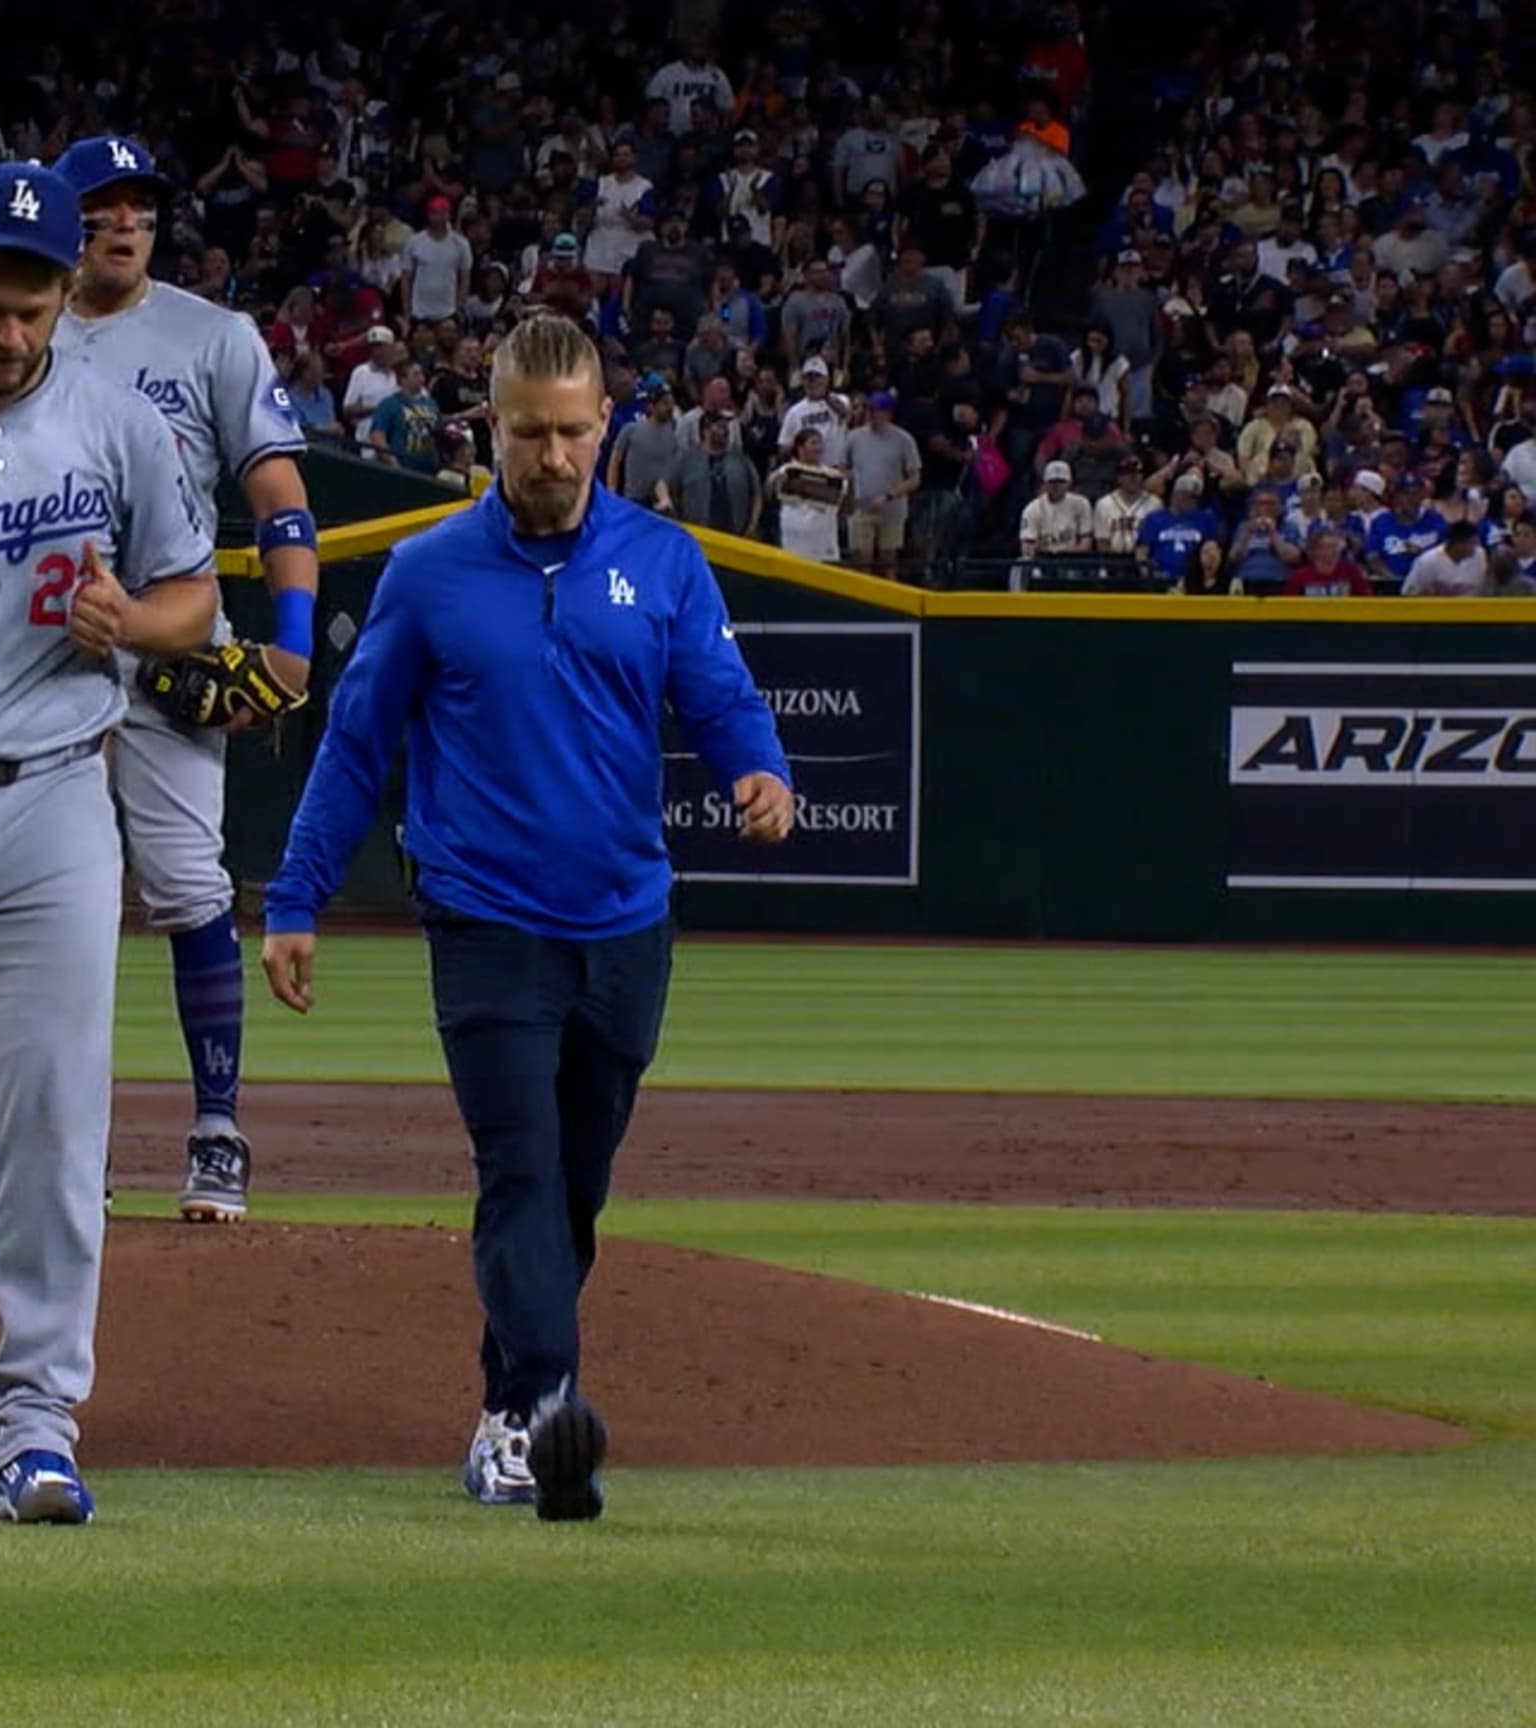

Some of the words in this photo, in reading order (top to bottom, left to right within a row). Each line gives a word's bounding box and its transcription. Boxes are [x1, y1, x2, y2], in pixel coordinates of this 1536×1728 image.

[107, 140, 138, 170] LA
[8, 179, 41, 222] LA
[29, 553, 92, 627] 2
[607, 567, 636, 606] LA
